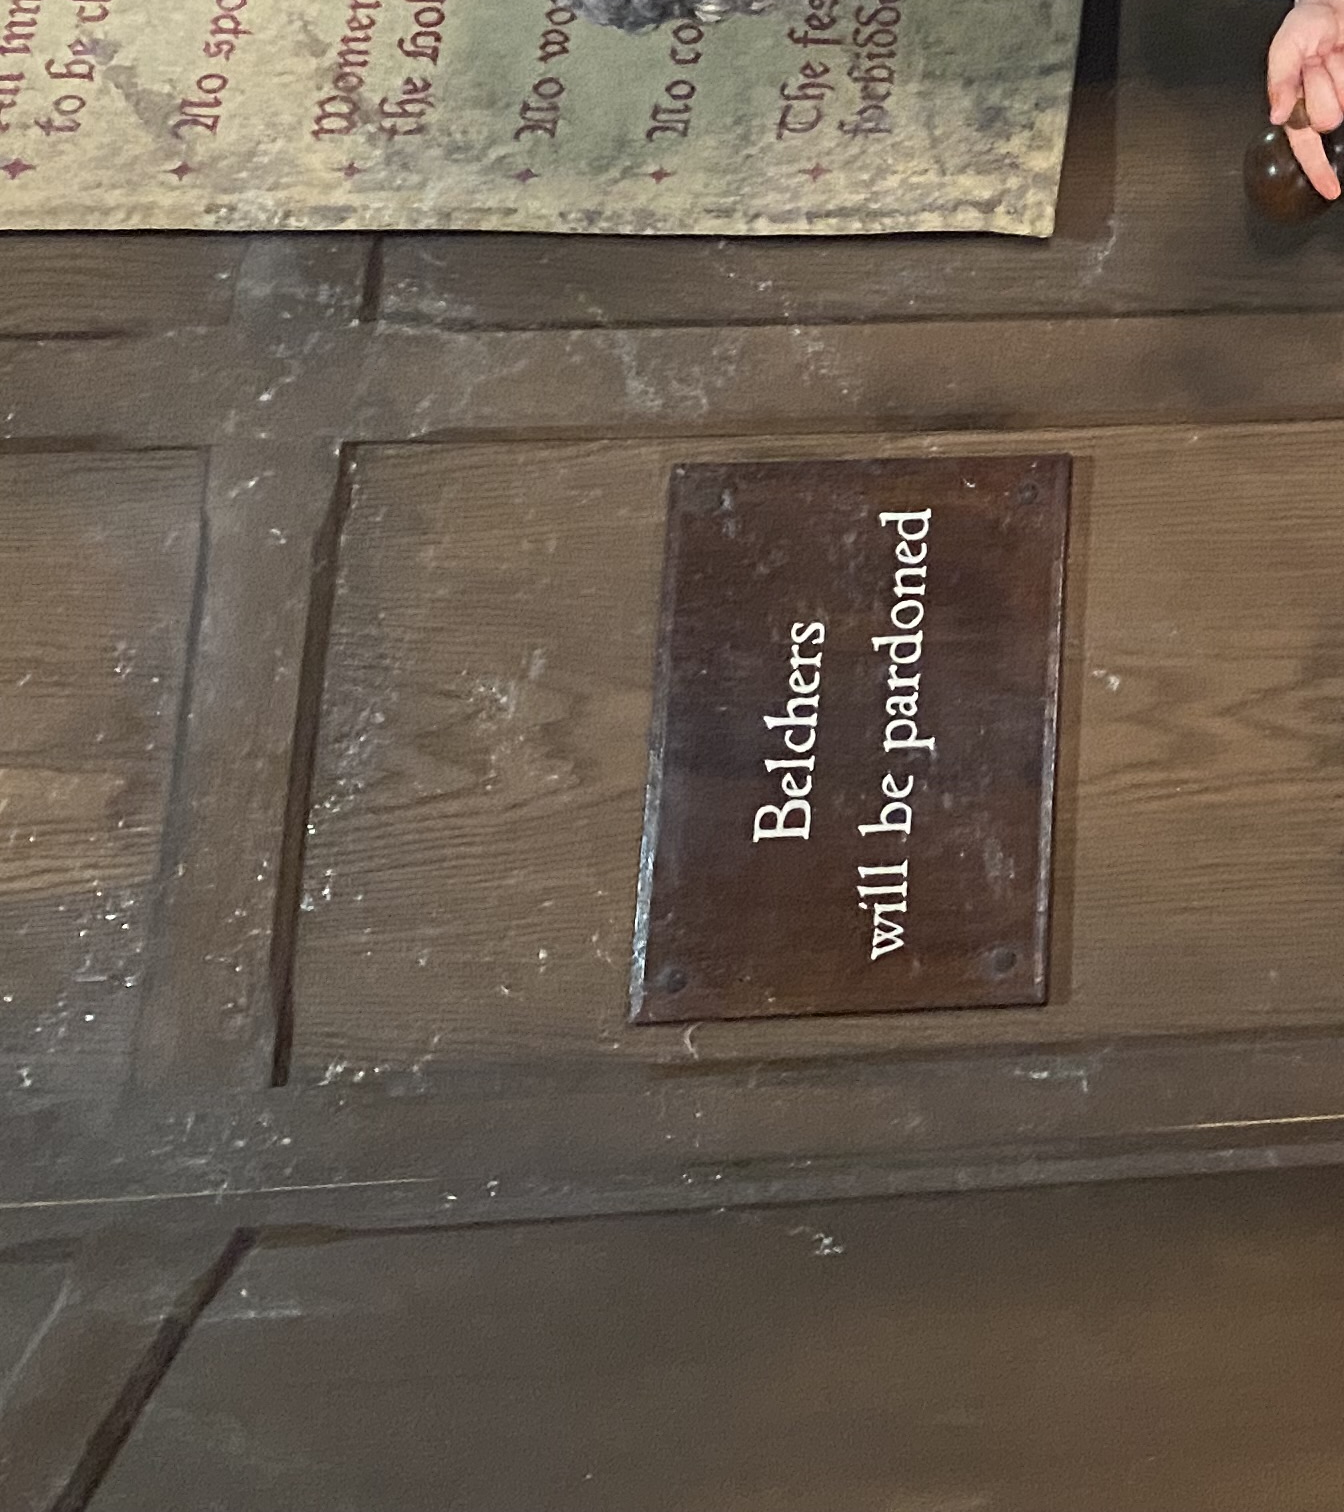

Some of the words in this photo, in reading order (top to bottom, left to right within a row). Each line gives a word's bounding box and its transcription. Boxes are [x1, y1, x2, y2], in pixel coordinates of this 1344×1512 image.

[45, 38, 97, 81] be
[34, 95, 86, 136] to
[169, 73, 228, 140] No
[377, 76, 435, 140] the
[513, 76, 565, 142] No
[645, 79, 697, 143] No
[774, 60, 836, 140] The
[871, 508, 936, 752] pardoned
[752, 620, 826, 843] Belchers
[858, 773, 914, 837] be
[857, 859, 910, 960] will
